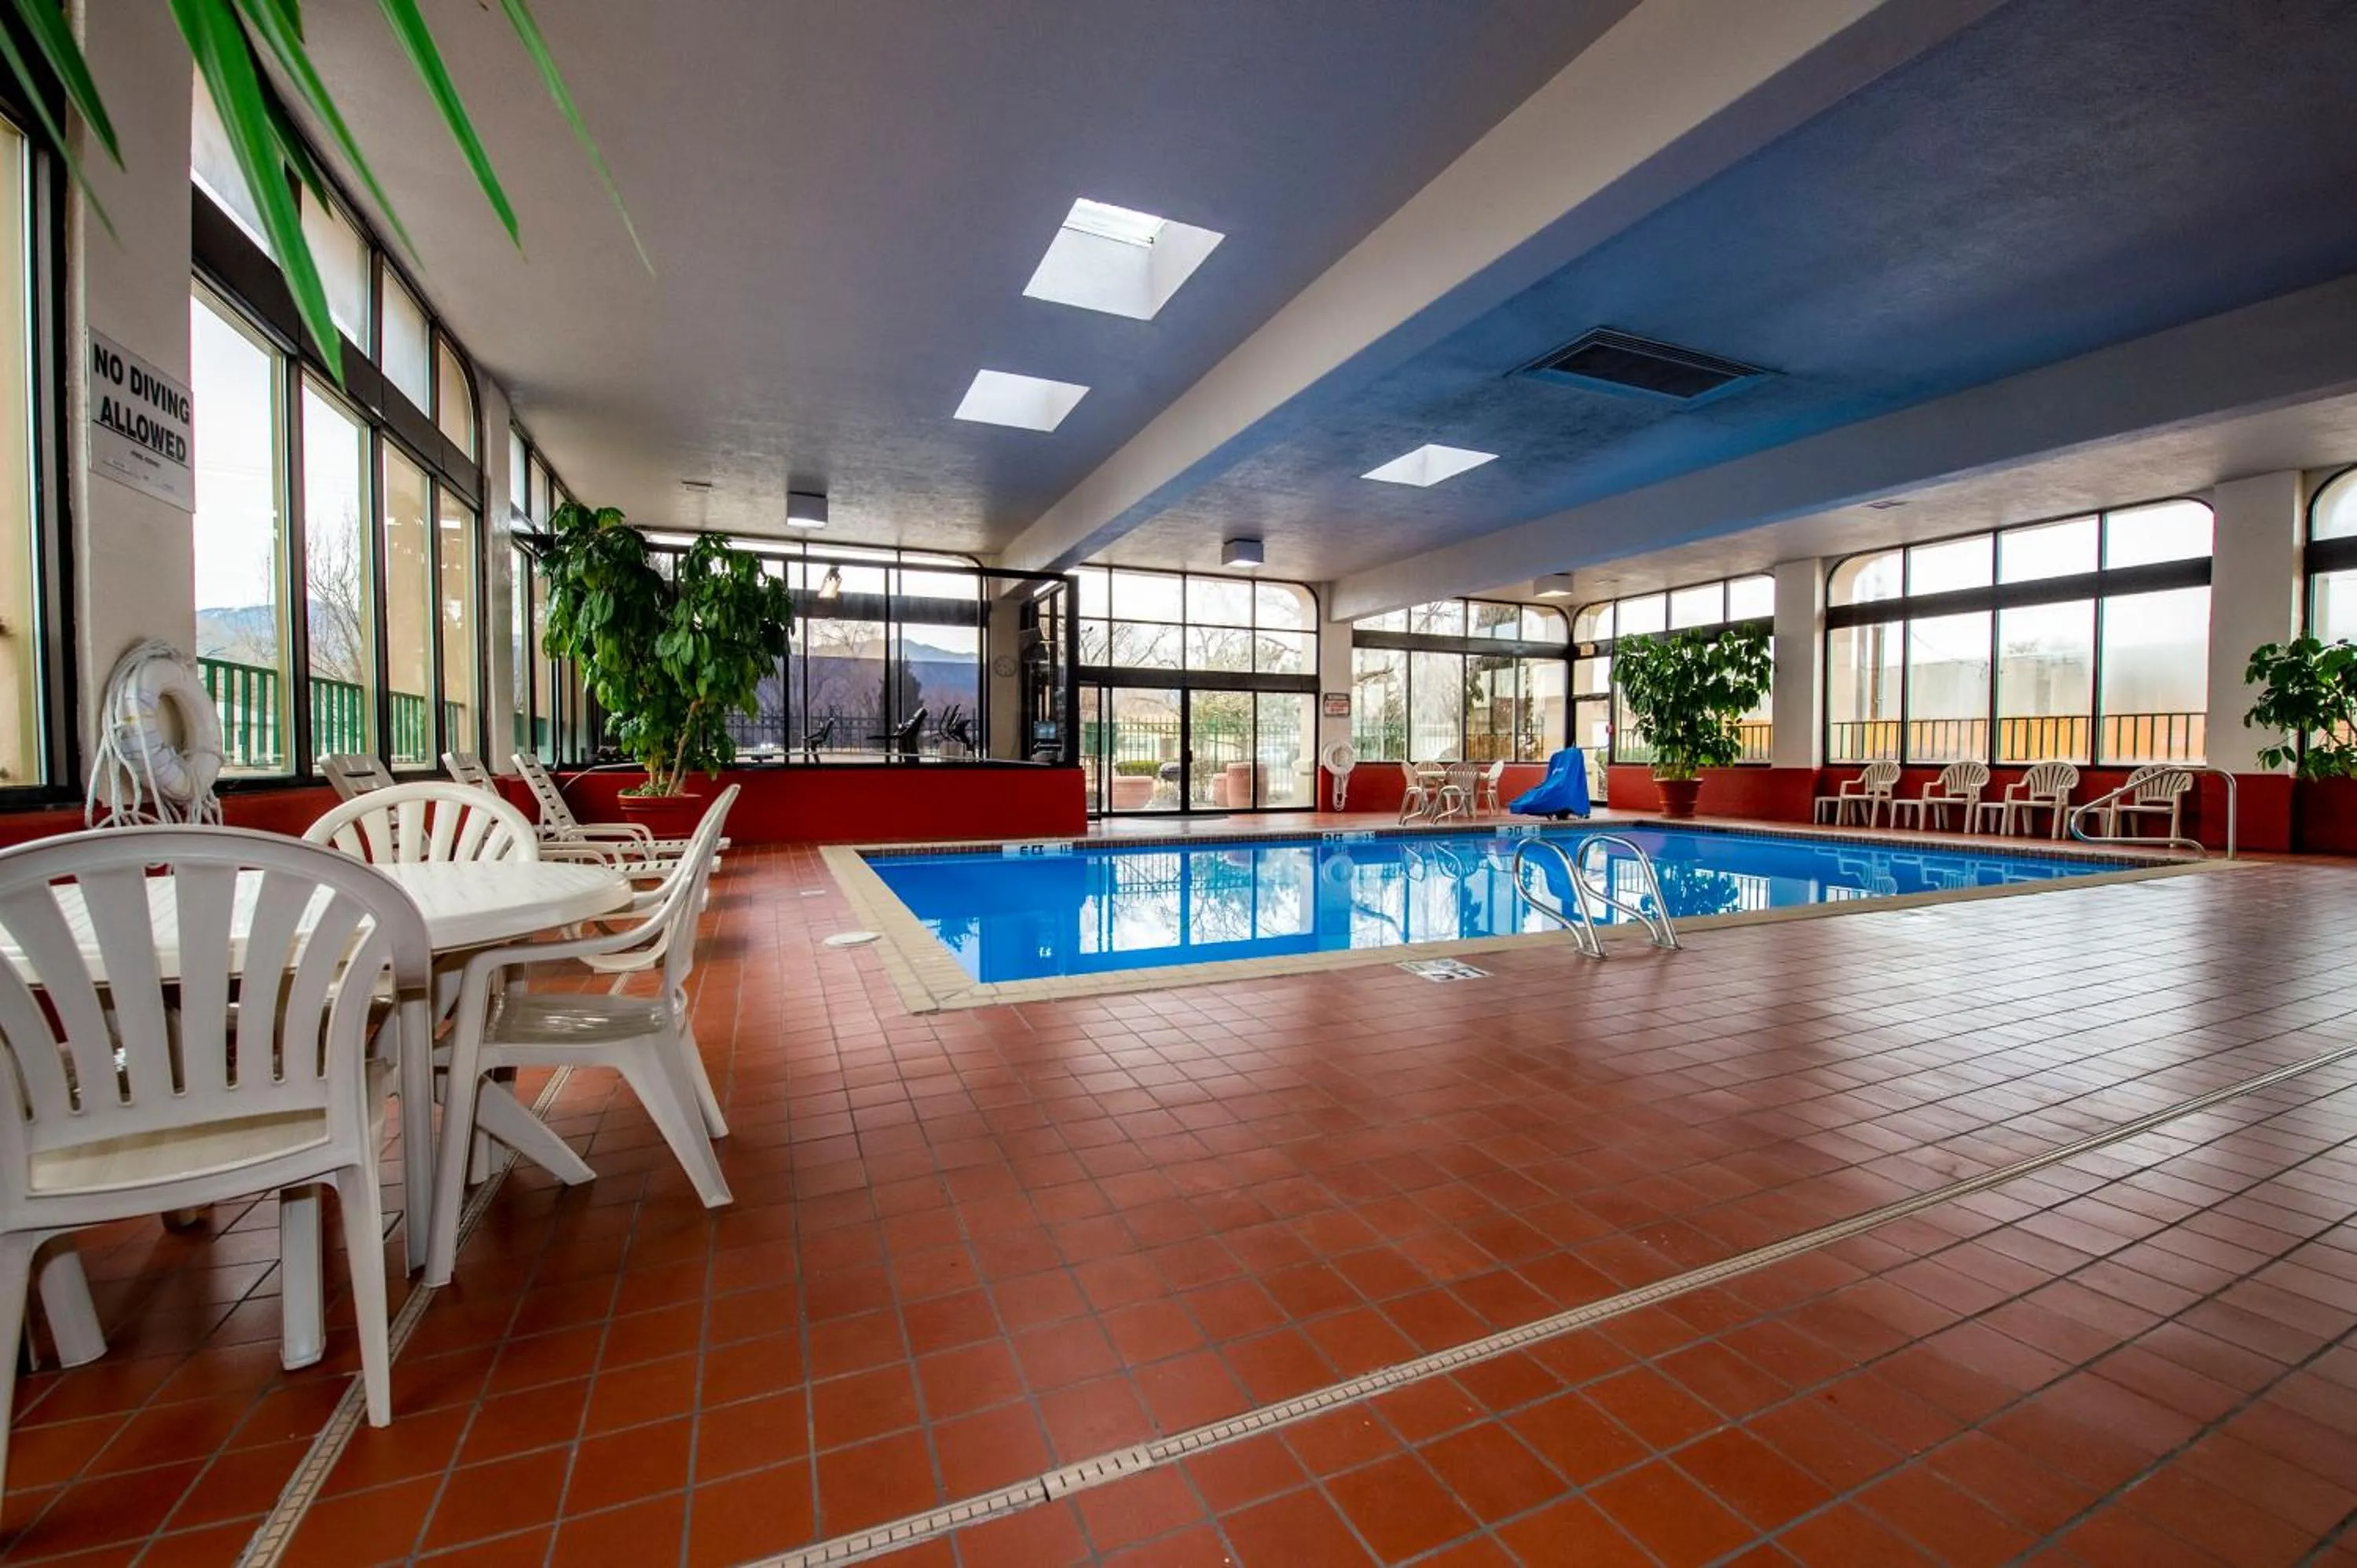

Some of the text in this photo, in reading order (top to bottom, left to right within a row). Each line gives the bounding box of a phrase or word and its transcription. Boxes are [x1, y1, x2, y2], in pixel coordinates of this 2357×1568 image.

[93, 343, 190, 426] NO DIVING
[100, 395, 186, 462] ALLOWED
